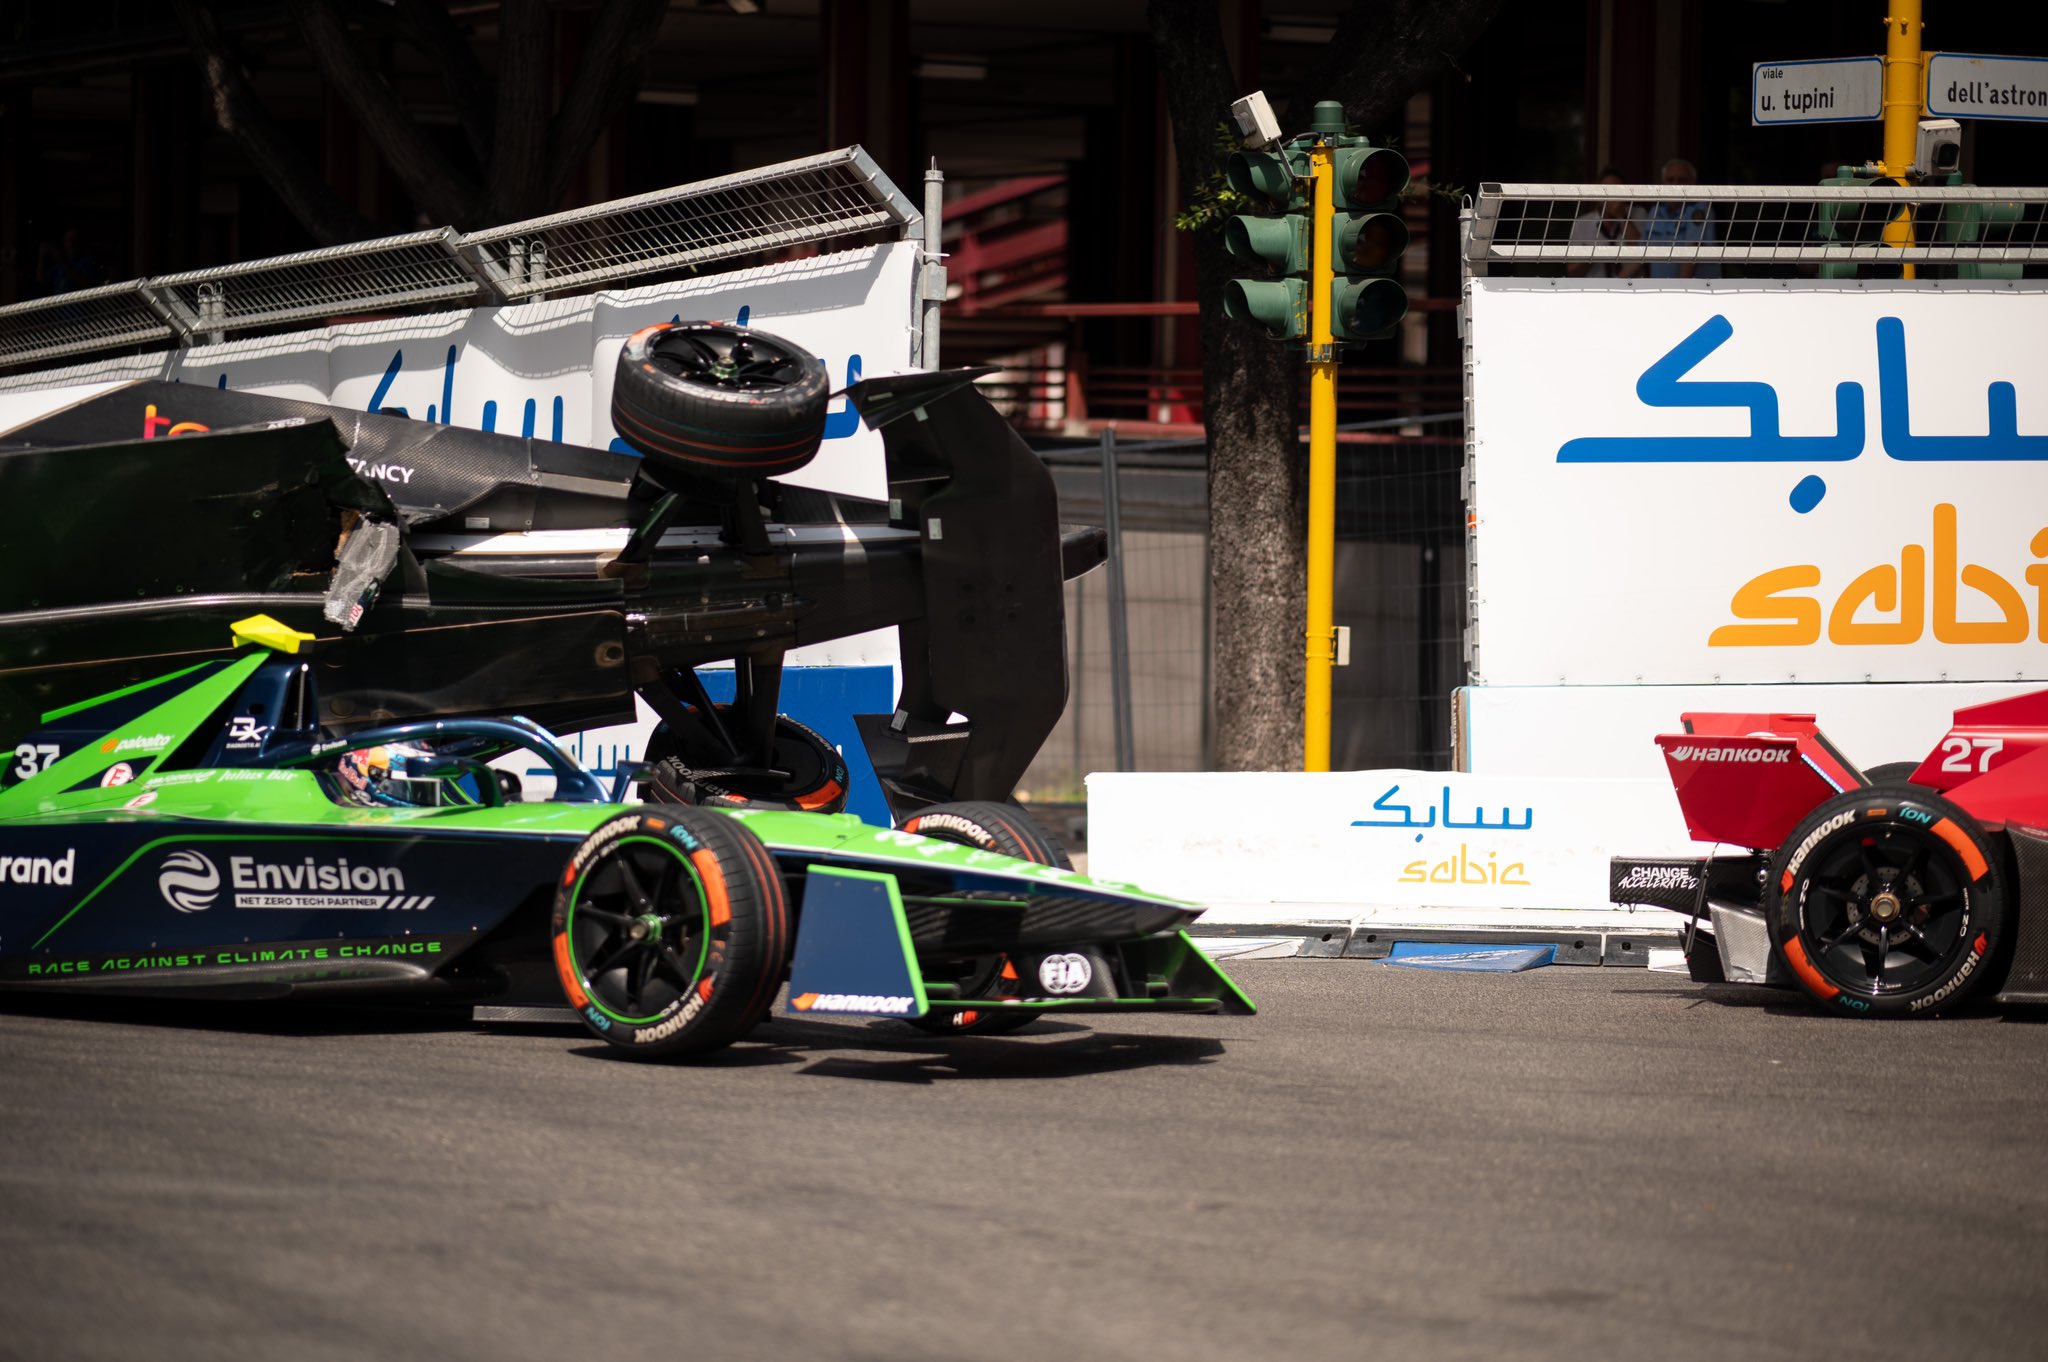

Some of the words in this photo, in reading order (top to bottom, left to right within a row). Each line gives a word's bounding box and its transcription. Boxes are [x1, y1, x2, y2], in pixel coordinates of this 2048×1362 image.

[1762, 67, 1783, 79] viale
[1761, 95, 1776, 111] u.
[1784, 87, 1834, 113] tupini
[1947, 81, 2048, 107] dell'astron
[15, 743, 60, 780] 37
[1940, 738, 2003, 772] 27
[229, 855, 406, 891] Envision
[1397, 843, 1532, 885] sabic
[240, 896, 261, 905] NET
[264, 896, 292, 906] ZERO
[296, 897, 325, 906] TECH
[328, 897, 377, 907] PARTNER
[28, 961, 90, 975] RACE
[100, 954, 206, 971] AGAINST
[217, 947, 329, 964] CLIMATE
[340, 941, 442, 957] CHANGE
[1041, 960, 1087, 989] FIA
